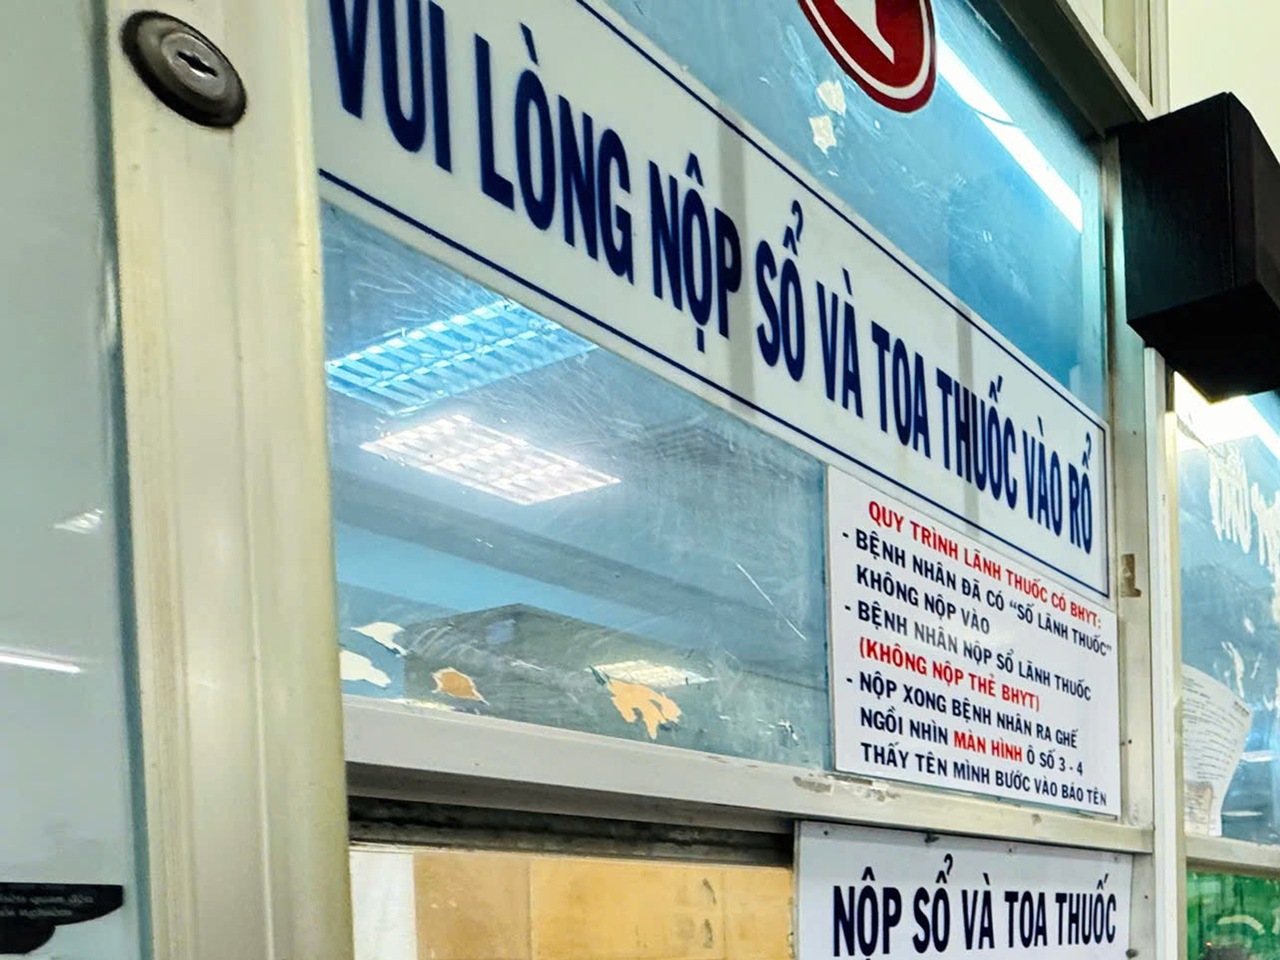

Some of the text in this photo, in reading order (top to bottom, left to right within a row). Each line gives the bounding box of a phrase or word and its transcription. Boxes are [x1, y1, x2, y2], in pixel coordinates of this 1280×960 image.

[330, 0, 1093, 555] VUI LÒNG NỘP SỔ VÀ TOA THUỐC VÀO RỔ
[856, 529, 905, 568] BỆNH
[913, 554, 956, 591] NHÂN
[962, 577, 980, 600] ĐÃ
[986, 586, 1005, 611] CÓ
[1038, 613, 1068, 640] LÃNH
[856, 564, 990, 635] KHÔNG NỘP VÀO
[868, 501, 1101, 629] QUY TRÌNH LÃNH THUỐC CÓ BHYT:
[858, 602, 907, 636] BỆNH
[914, 621, 958, 653] NHÂN
[963, 640, 992, 665] NỘP
[996, 648, 1014, 673] SỔ
[1019, 661, 1051, 687] LÃNH
[1054, 672, 1091, 700] THUỐC
[859, 637, 1040, 713] (KHÔNG NỘP THẺ BHYT)
[859, 671, 897, 699] NỘP
[903, 685, 946, 713] XONG
[952, 699, 991, 726] BỆNH
[997, 712, 1031, 736] NHÂN
[1036, 723, 1052, 742] RA
[1056, 729, 1079, 748] GHẾ
[860, 706, 902, 735] NGỒI
[910, 720, 948, 745] NHÌN
[954, 729, 986, 754] MÀN
[991, 739, 1022, 762] HÌNH
[1027, 745, 1035, 765] Ô
[1040, 750, 1055, 769] SỐ
[1059, 756, 1066, 772] 3
[1077, 761, 1083, 775] 4
[861, 742, 1107, 806] THẤY TÊN MÌNH BƯỚC VÀO BÁO TÊN
[912, 853, 953, 954] SỔ
[961, 872, 995, 950] VÀ
[1005, 891, 1047, 948] TOA
[1055, 873, 1117, 946] THUỐC
